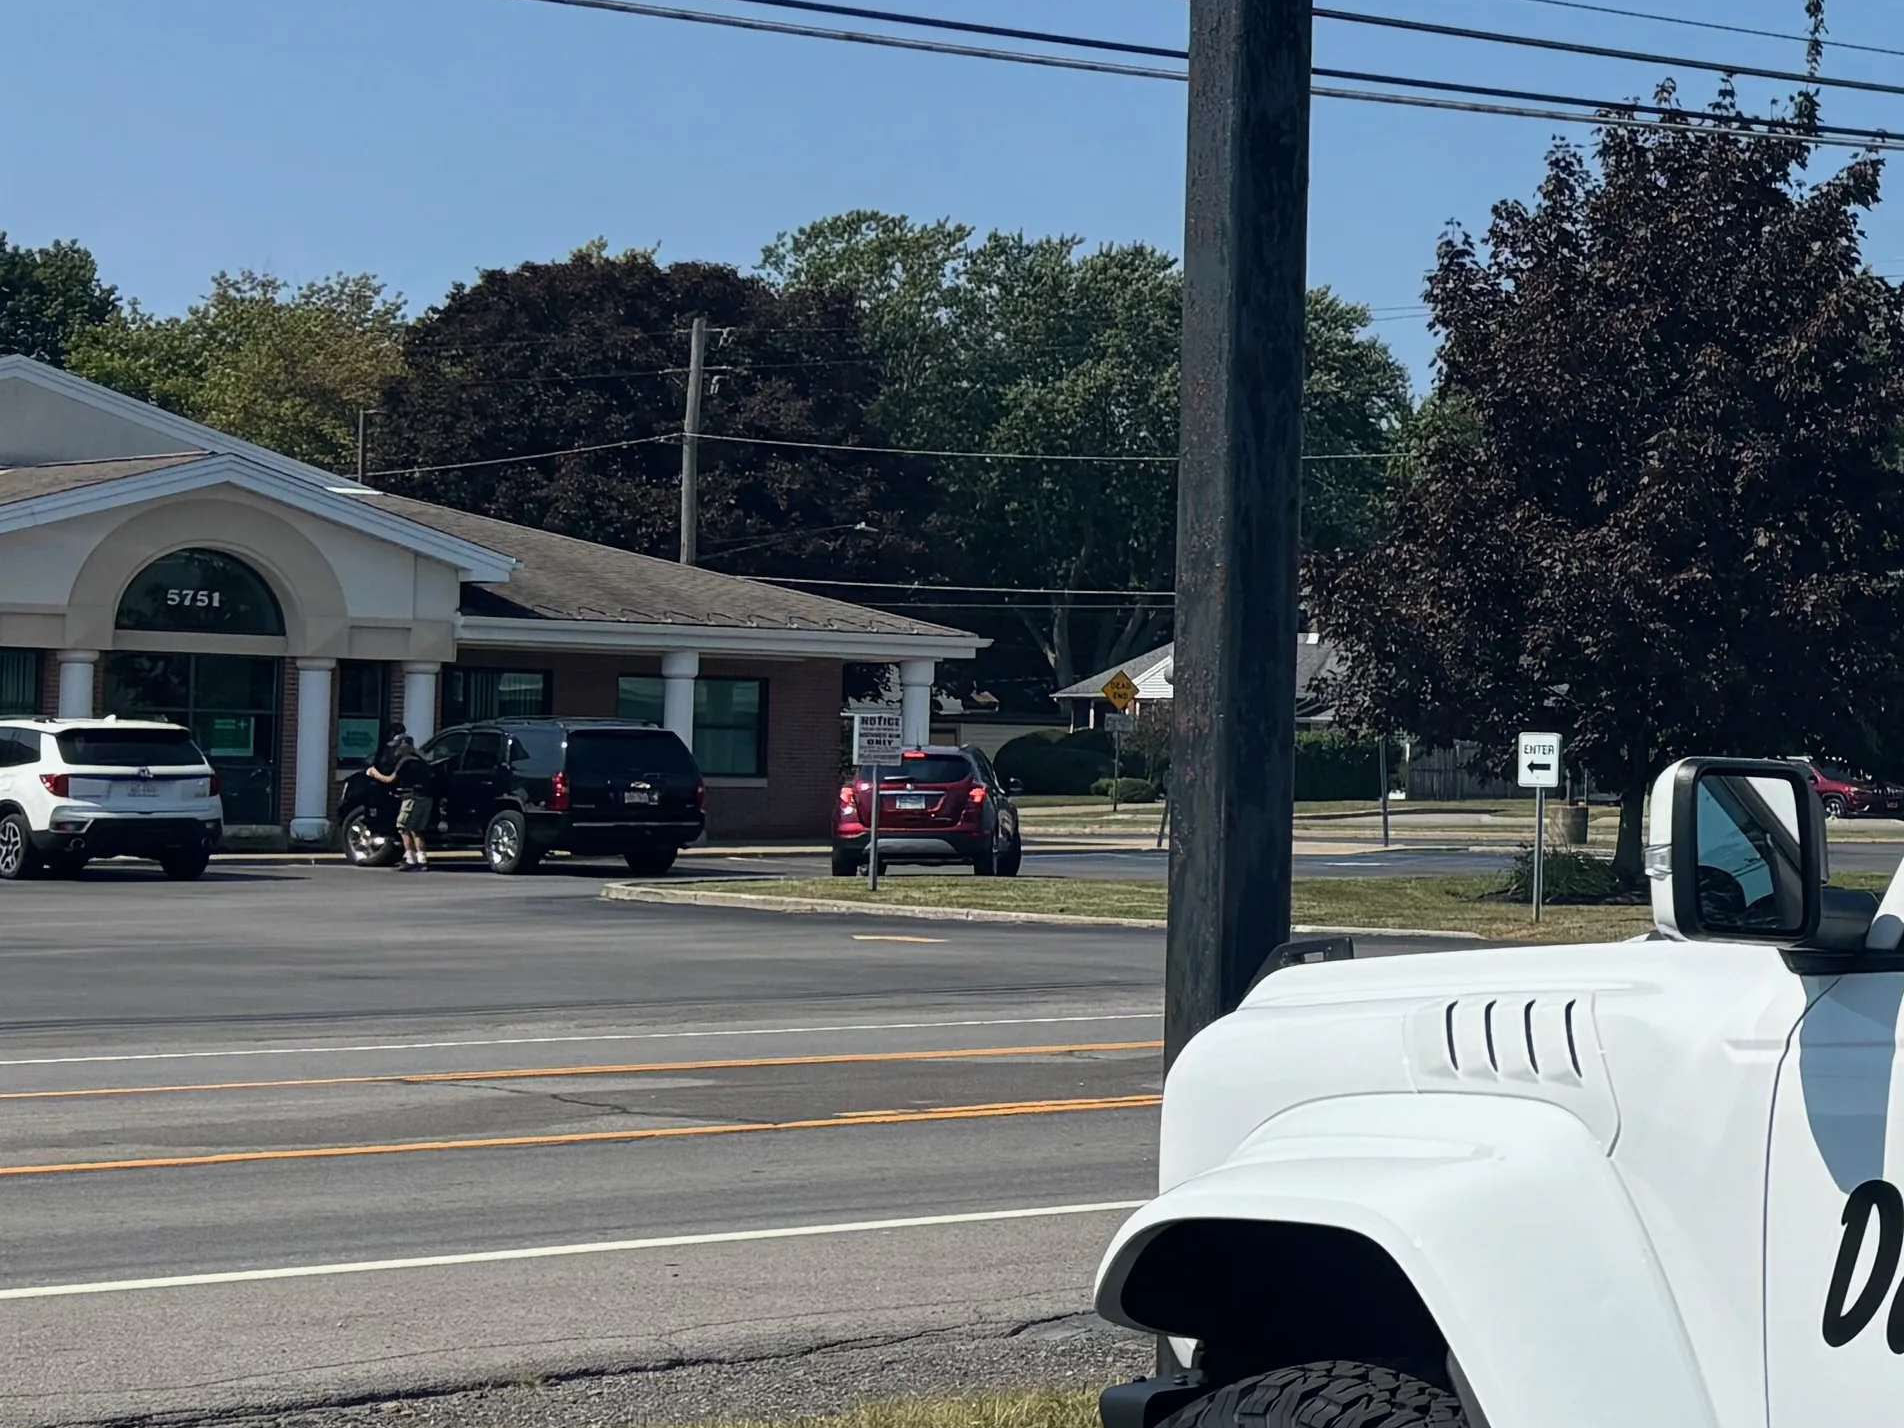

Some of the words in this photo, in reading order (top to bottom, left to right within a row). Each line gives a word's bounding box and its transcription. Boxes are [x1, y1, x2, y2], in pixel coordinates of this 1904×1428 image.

[166, 588, 221, 608] 5751
[1111, 681, 1132, 690] DEAD
[1113, 691, 1129, 700] END
[860, 716, 901, 727] NOTICE
[867, 738, 894, 746] ONLY
[1524, 744, 1555, 756] ENTER
